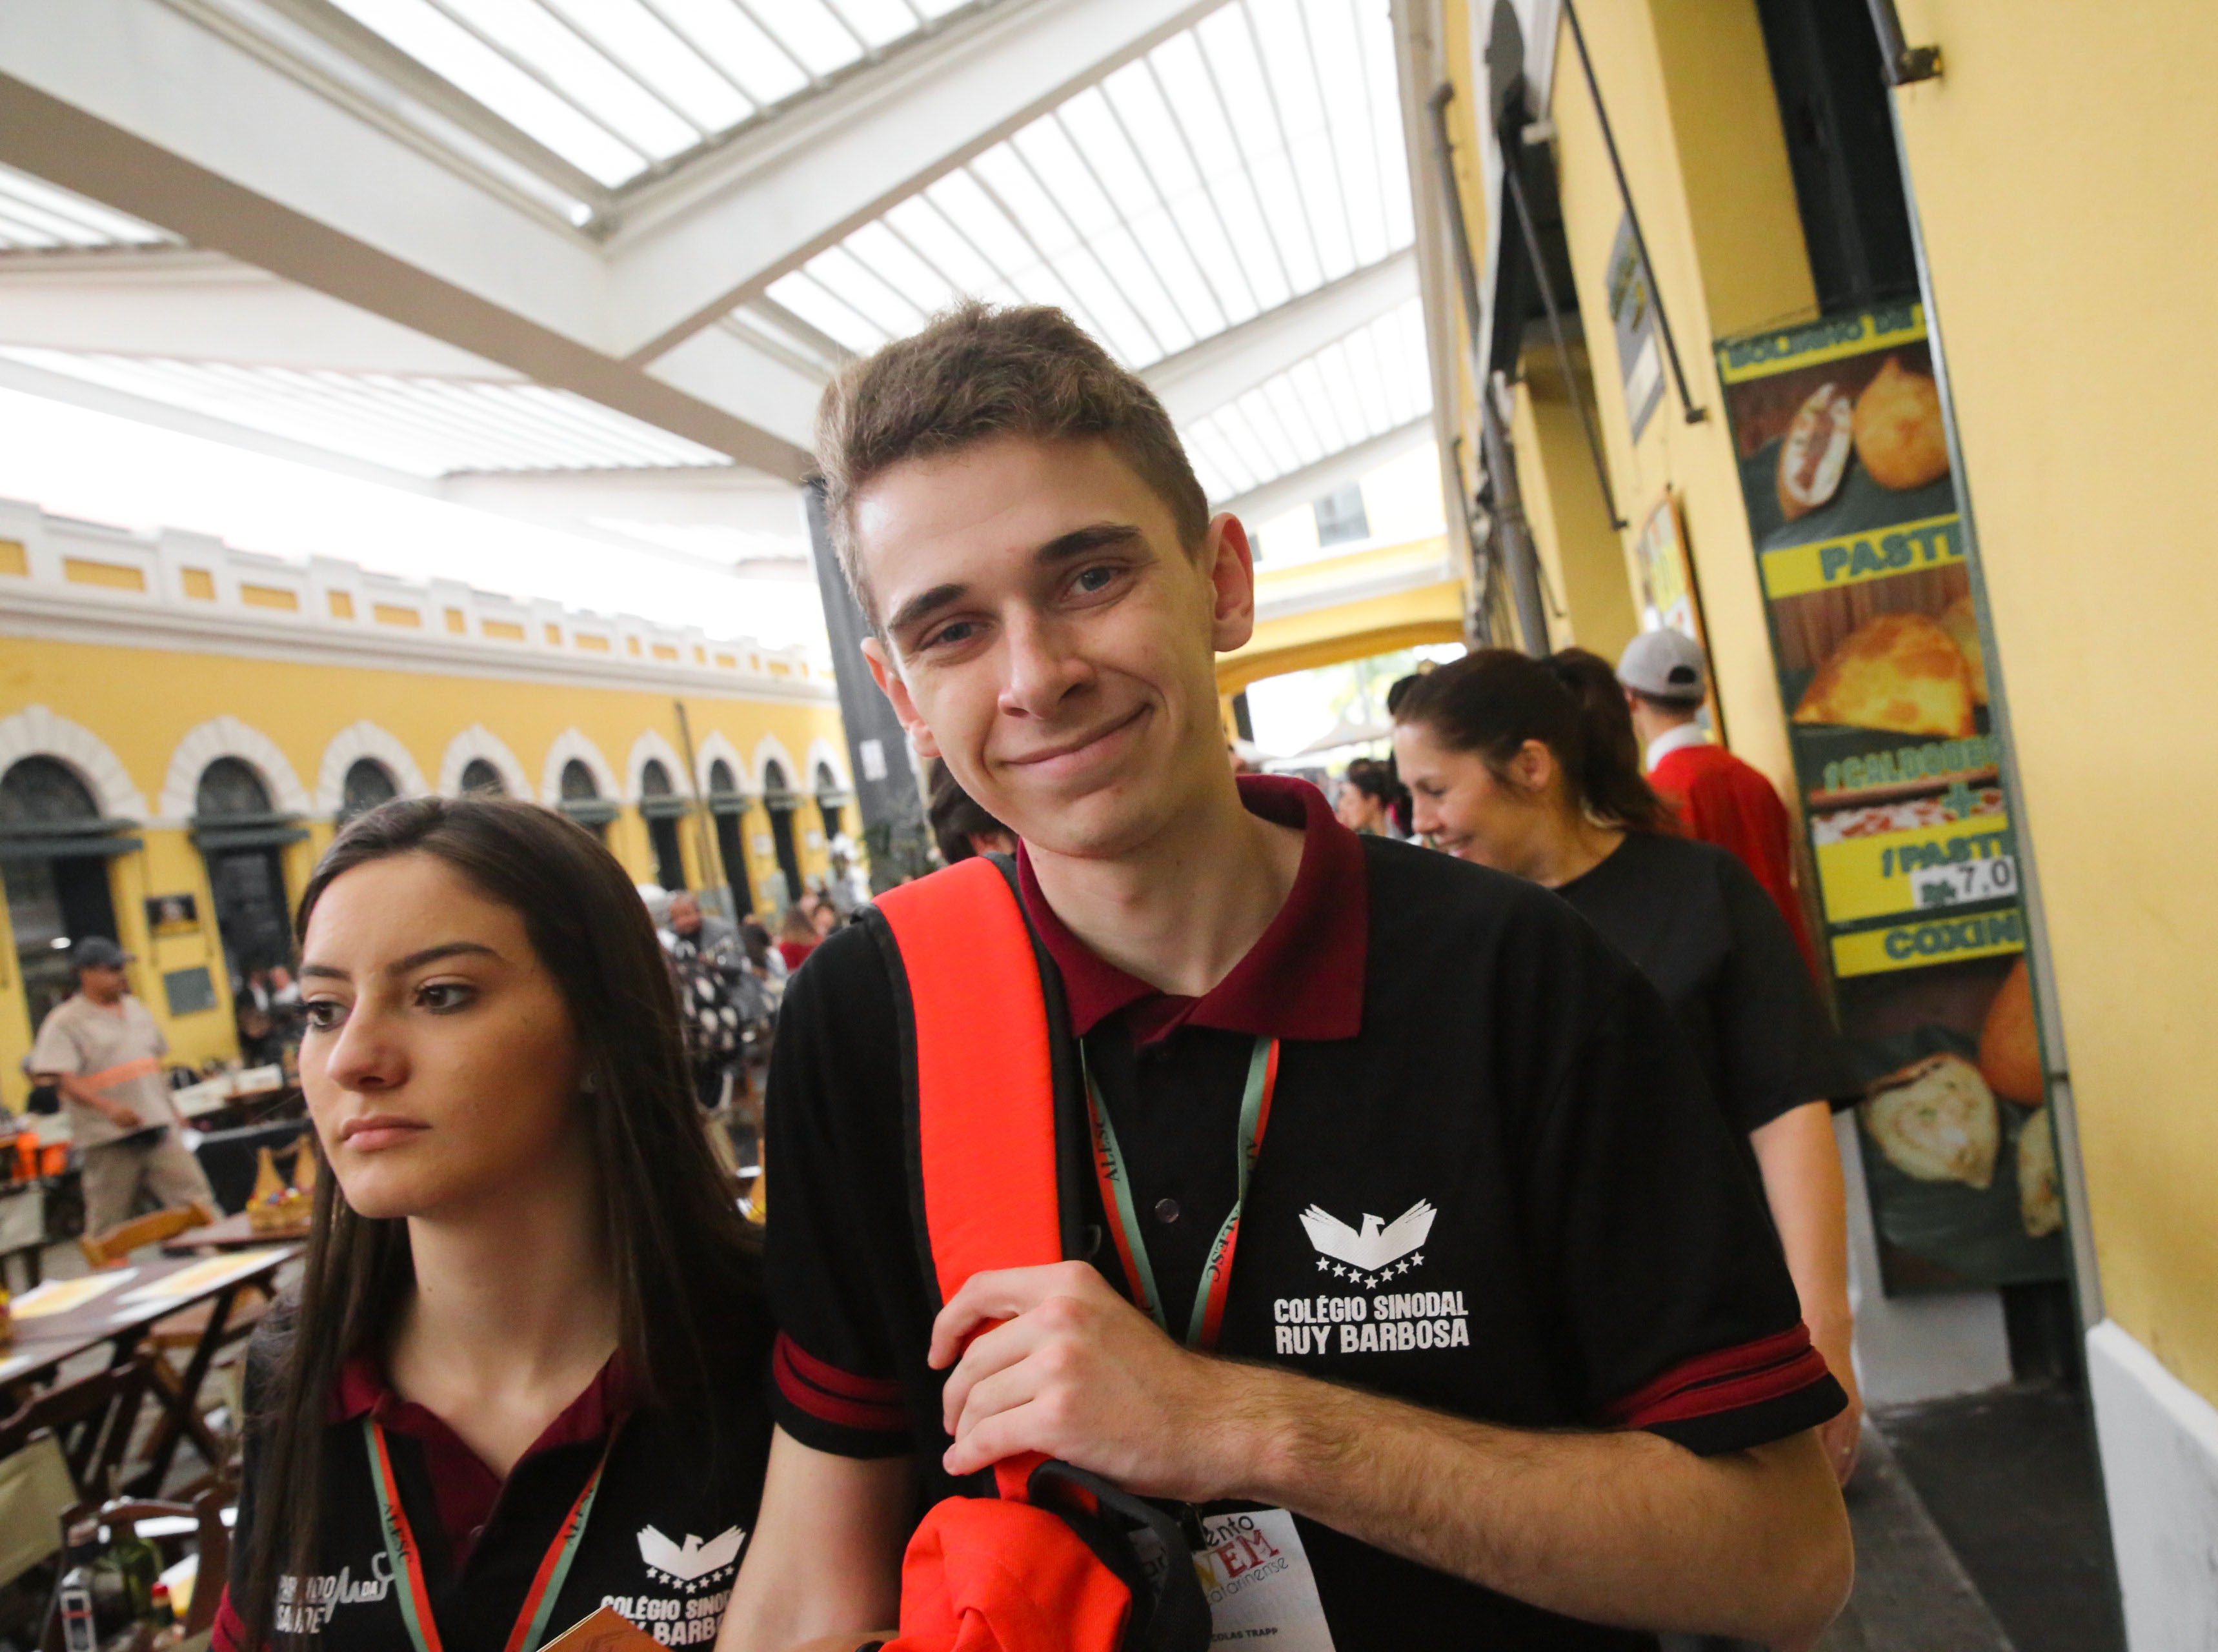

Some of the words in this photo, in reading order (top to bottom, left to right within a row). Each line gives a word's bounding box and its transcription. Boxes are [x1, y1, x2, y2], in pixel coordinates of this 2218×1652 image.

[1273, 1295, 1367, 1324] COLÉGIO
[1373, 1291, 1469, 1320] SINODAL
[1275, 1325, 1331, 1355] RUY
[1340, 1318, 1470, 1354] BARBOSA
[1245, 1627, 1278, 1638] TRAPP
